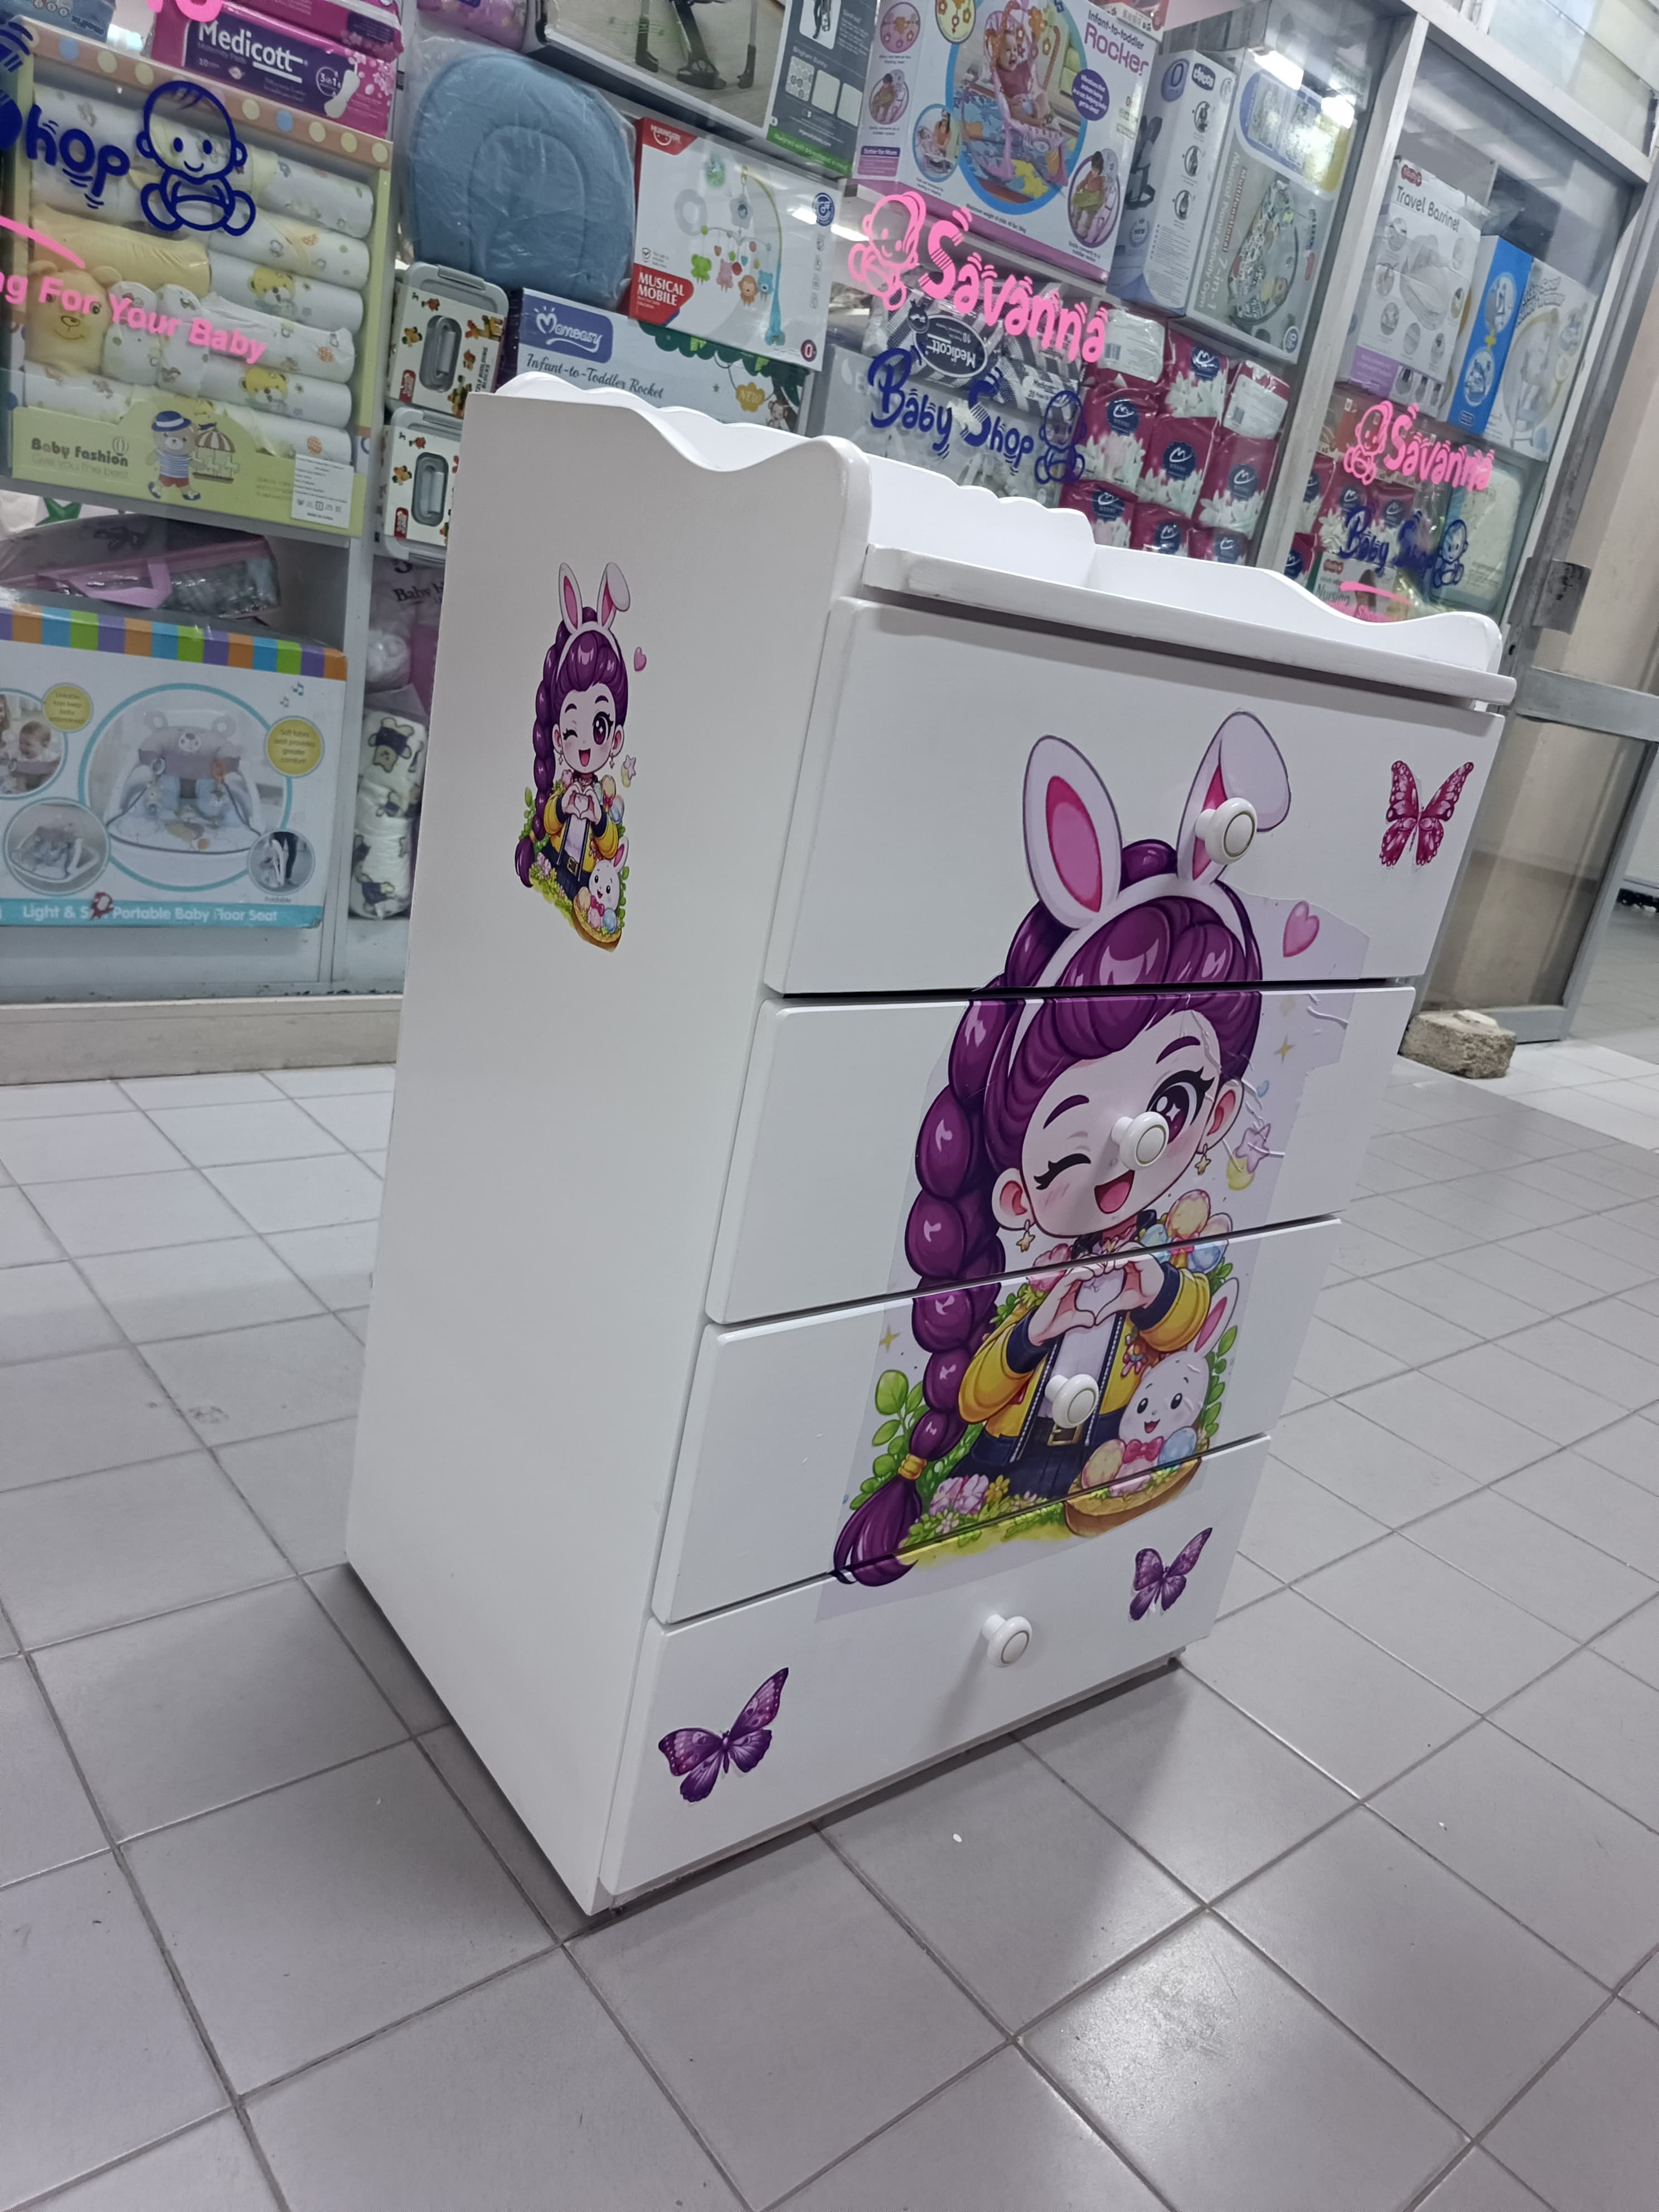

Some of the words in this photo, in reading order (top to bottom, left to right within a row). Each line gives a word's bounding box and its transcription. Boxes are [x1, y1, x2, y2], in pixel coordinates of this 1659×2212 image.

[198, 21, 303, 72] Medicott
[1084, 22, 1148, 73] Rocker
[1088, 10, 1144, 50] Infant-to-toddler
[0, 95, 130, 197] hop
[1223, 169, 1246, 251] Multifunctional
[1396, 185, 1426, 213] Travel
[1428, 202, 1459, 232] Bassinet
[638, 272, 685, 296] MUSICAL
[638, 284, 677, 306] MOBILE
[919, 219, 1107, 362] Savanna
[1207, 257, 1227, 309] 7-in-1
[39, 276, 99, 314] For
[109, 293, 182, 336] Your
[188, 317, 266, 363] Baby
[536, 313, 602, 352] Momeasy
[527, 353, 625, 389] Infant-to-Toddler
[926, 339, 976, 368] Medicott
[867, 348, 952, 450] Baby
[963, 380, 1034, 468] Shop
[31, 438, 70, 459] Baby
[1384, 414, 1494, 491] Savanna
[1340, 506, 1389, 578] Baby
[23, 905, 59, 921] Light
[64, 905, 76, 919] &
[113, 906, 171, 920] Portable
[174, 908, 210, 923] Baby
[249, 909, 277, 921] Seat
